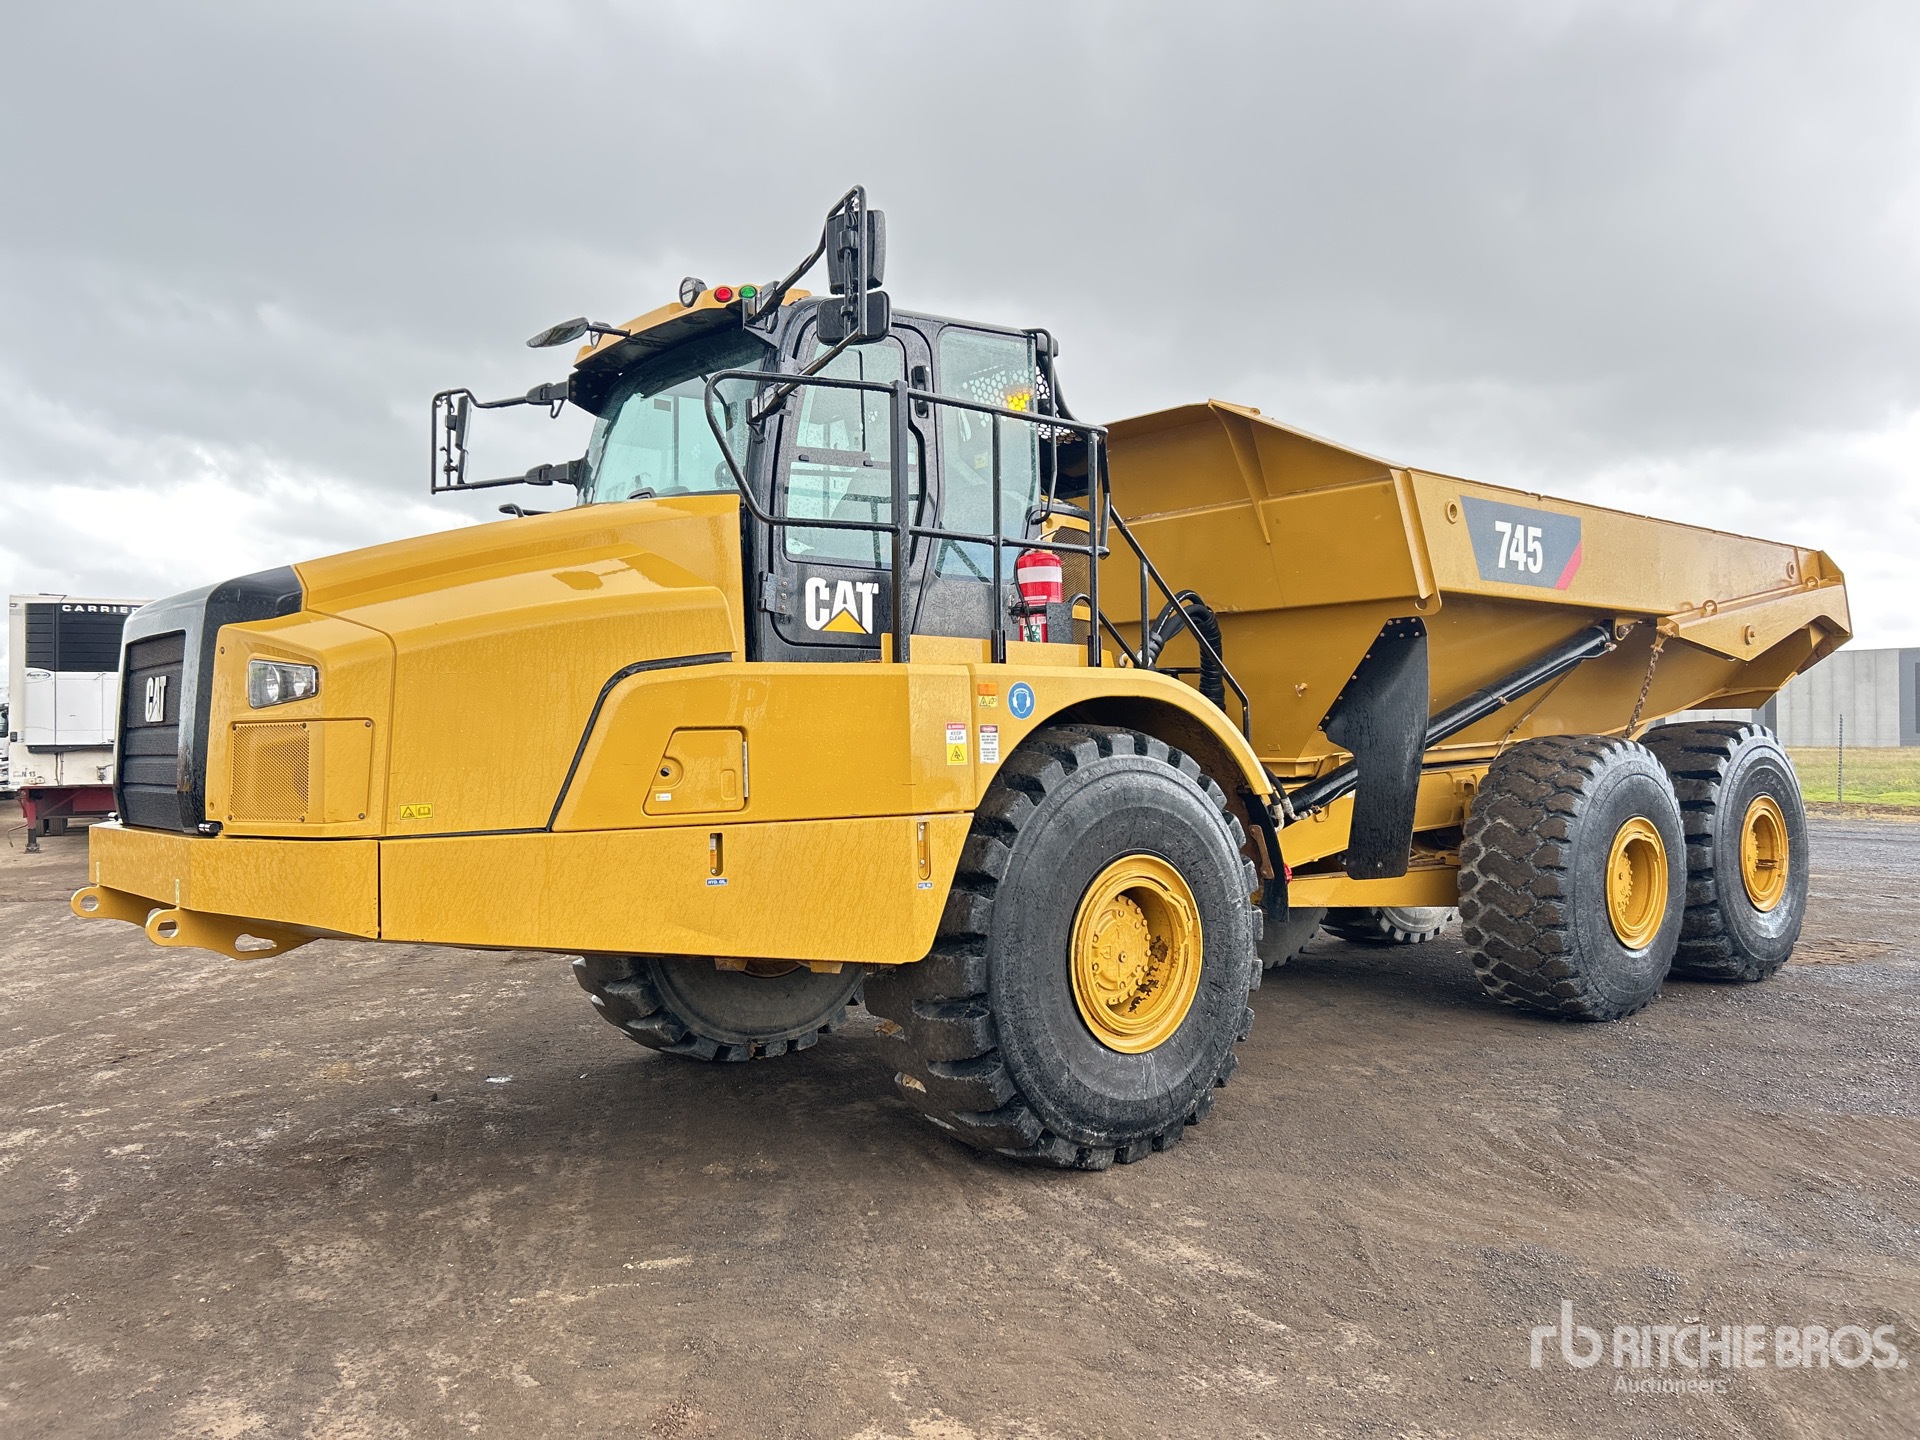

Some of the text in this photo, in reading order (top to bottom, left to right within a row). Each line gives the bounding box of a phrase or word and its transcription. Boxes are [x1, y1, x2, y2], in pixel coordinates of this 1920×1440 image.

[1494, 520, 1544, 574] 745
[805, 577, 879, 634] CAT
[145, 675, 167, 722] CAT
